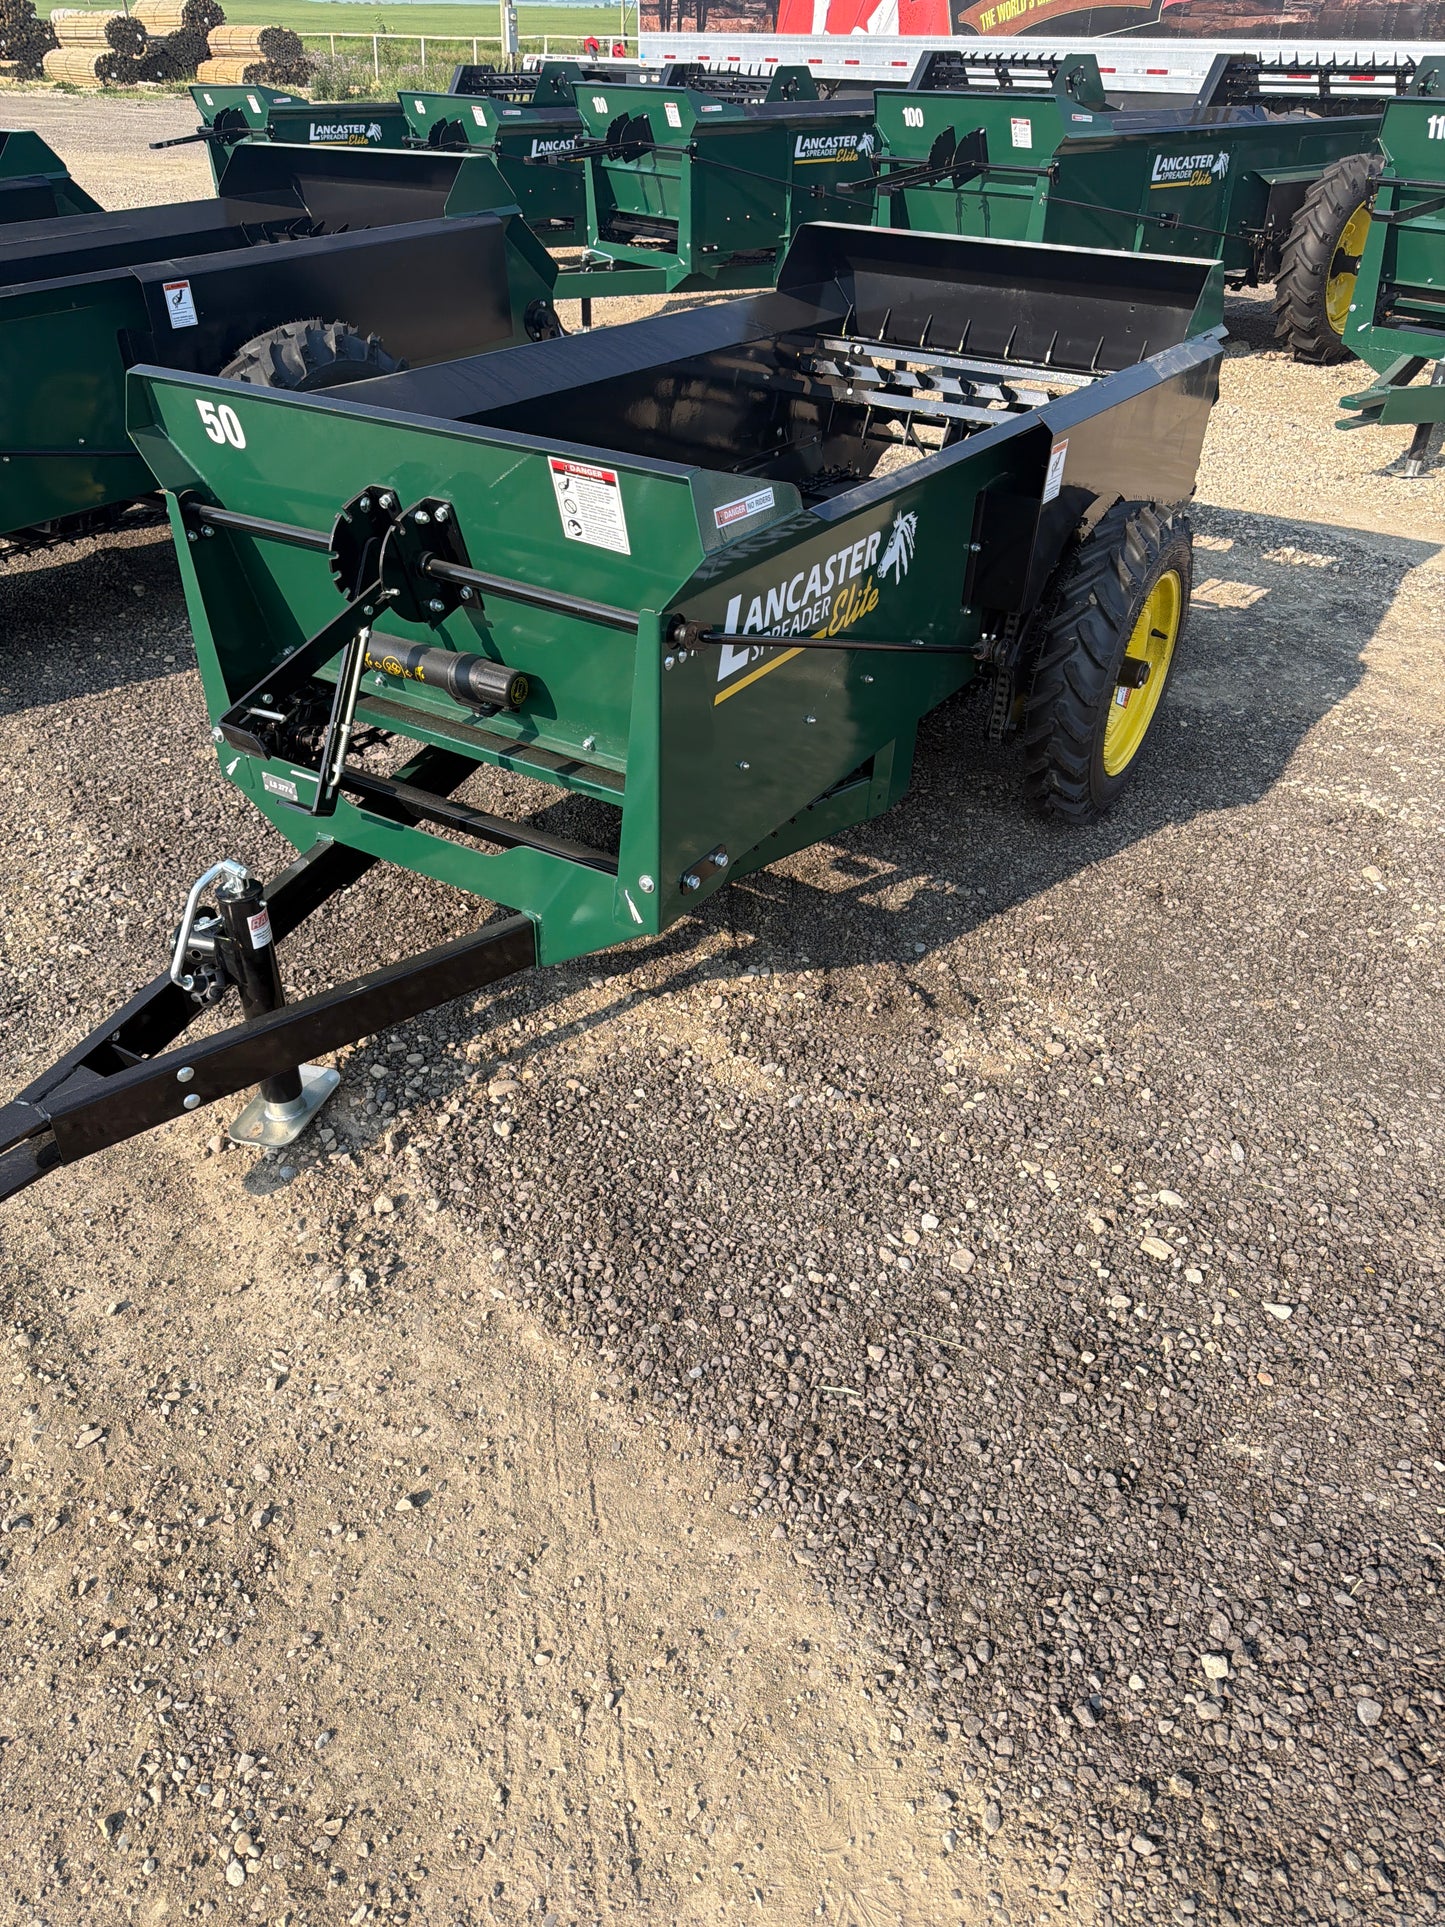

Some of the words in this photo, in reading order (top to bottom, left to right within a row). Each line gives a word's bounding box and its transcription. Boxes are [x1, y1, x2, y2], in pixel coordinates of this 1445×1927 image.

[980, 8, 996, 32] THE
[592, 96, 608, 113] 100
[902, 107, 924, 127] 100
[309, 123, 366, 141] LANCASTER
[1427, 115, 1445, 139] 11
[348, 134, 369, 145] Elite
[531, 139, 576, 158] LANCAST
[794, 135, 857, 158] LANCASTER
[806, 148, 837, 157] SPREADER
[836, 148, 858, 162] Elite
[1151, 154, 1214, 181] LANCASTER
[1161, 170, 1192, 180] SPREADER
[1189, 170, 1212, 186] Elite
[195, 399, 246, 449] 50
[569, 464, 603, 478] DANGER
[723, 504, 745, 519] DANGER
[747, 501, 755, 510] NO
[717, 531, 881, 682] LANCASTER
[828, 575, 880, 637] Elite
